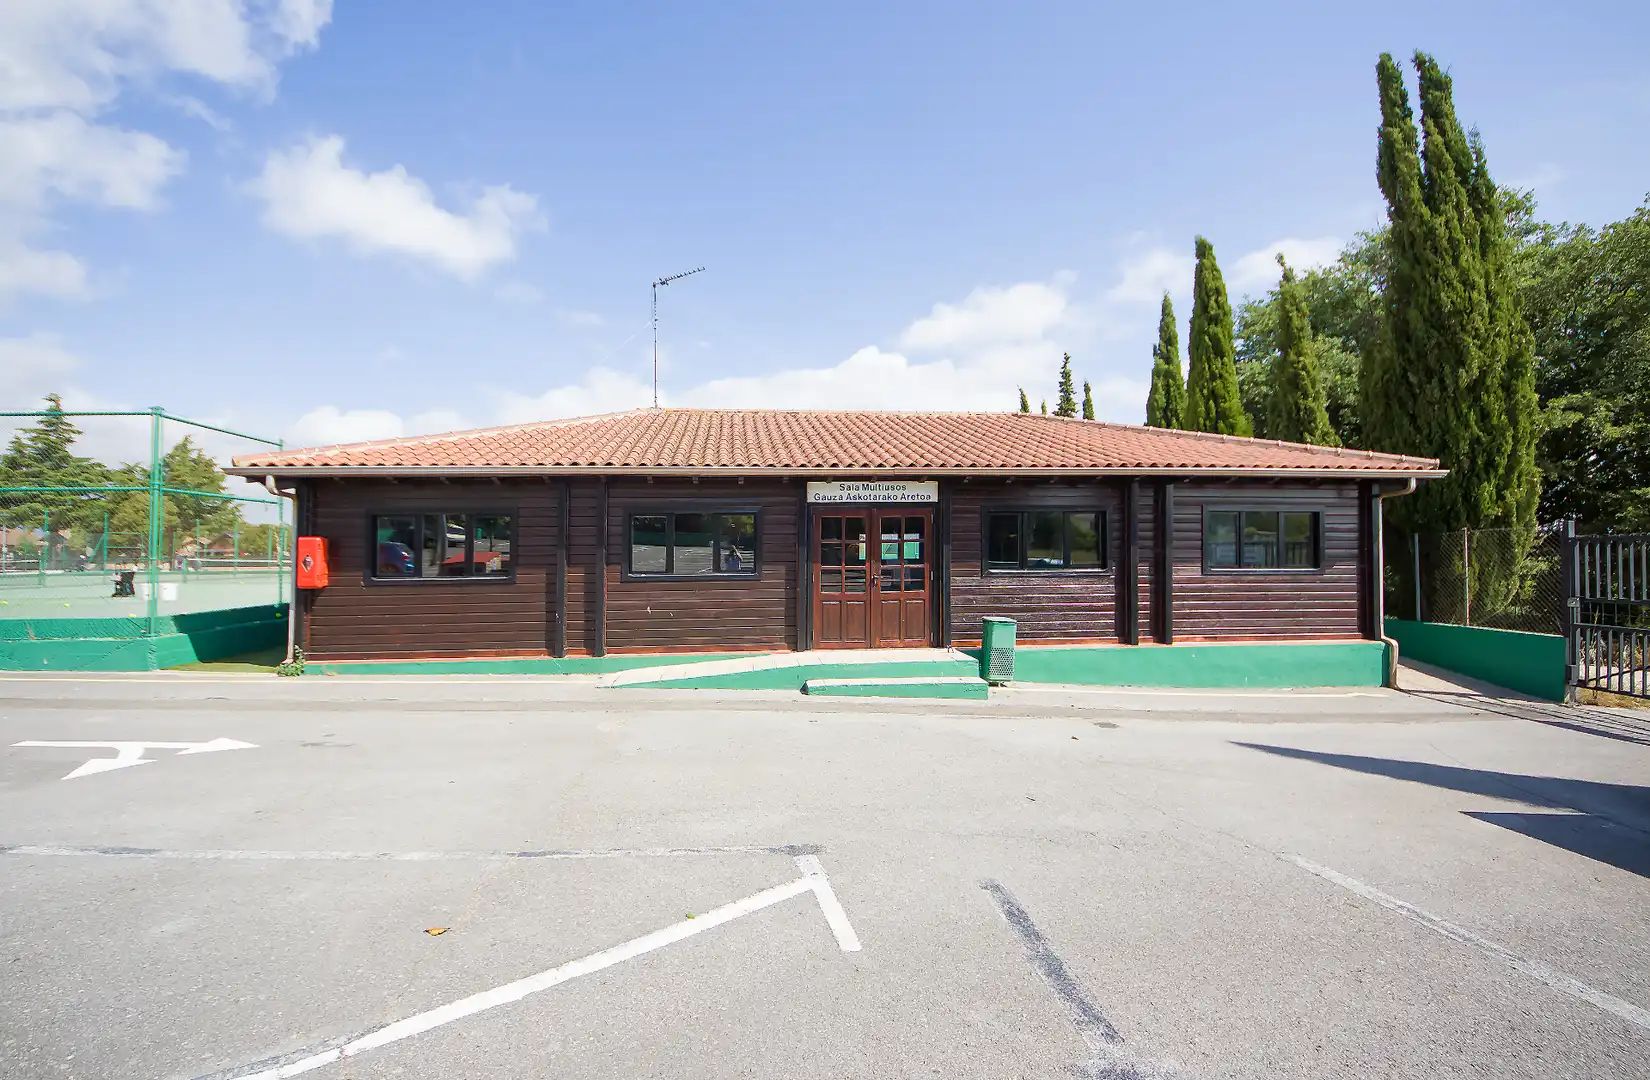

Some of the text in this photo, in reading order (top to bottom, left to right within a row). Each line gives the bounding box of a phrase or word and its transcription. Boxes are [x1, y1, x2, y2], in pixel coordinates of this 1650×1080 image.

[839, 483, 907, 491] Sala Multiusos
[813, 492, 931, 501] Gauza Askotarako Aretoa
